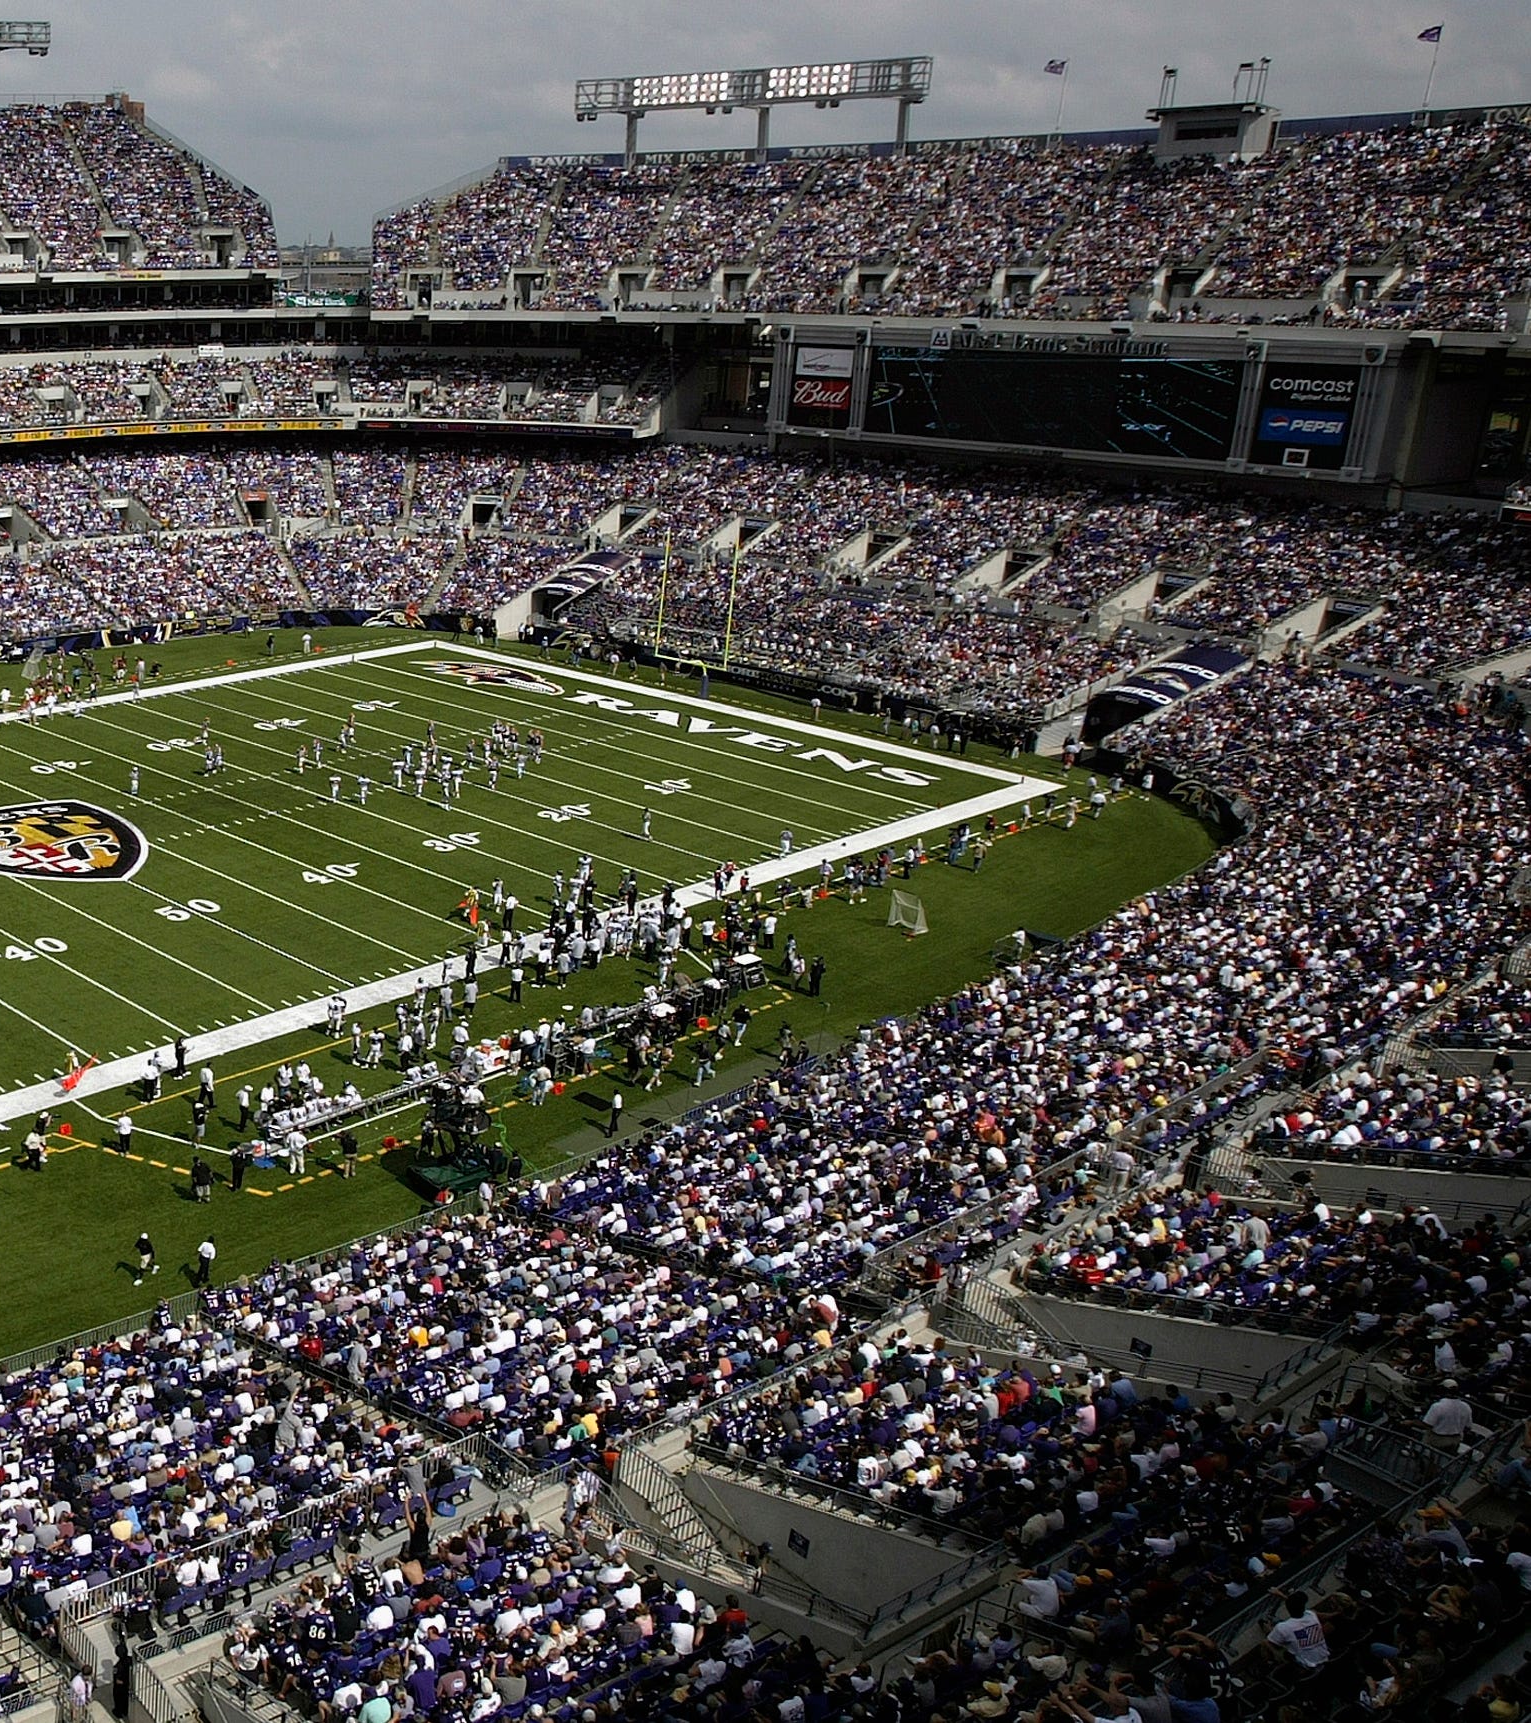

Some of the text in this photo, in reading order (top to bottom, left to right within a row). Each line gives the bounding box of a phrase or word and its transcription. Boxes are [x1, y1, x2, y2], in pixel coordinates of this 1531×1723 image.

[1483, 106, 1531, 126] TOY
[793, 380, 849, 404] Bud
[1270, 378, 1354, 393] comcast
[1289, 419, 1344, 433] PEPSI
[563, 690, 941, 786] RAVENS
[537, 804, 591, 822] 20
[422, 832, 481, 852] 30
[302, 864, 359, 884] 40
[154, 899, 221, 921] 50
[3, 937, 68, 961] 40
[365, 1581, 380, 1596] 52
[308, 1626, 326, 1640] 86
